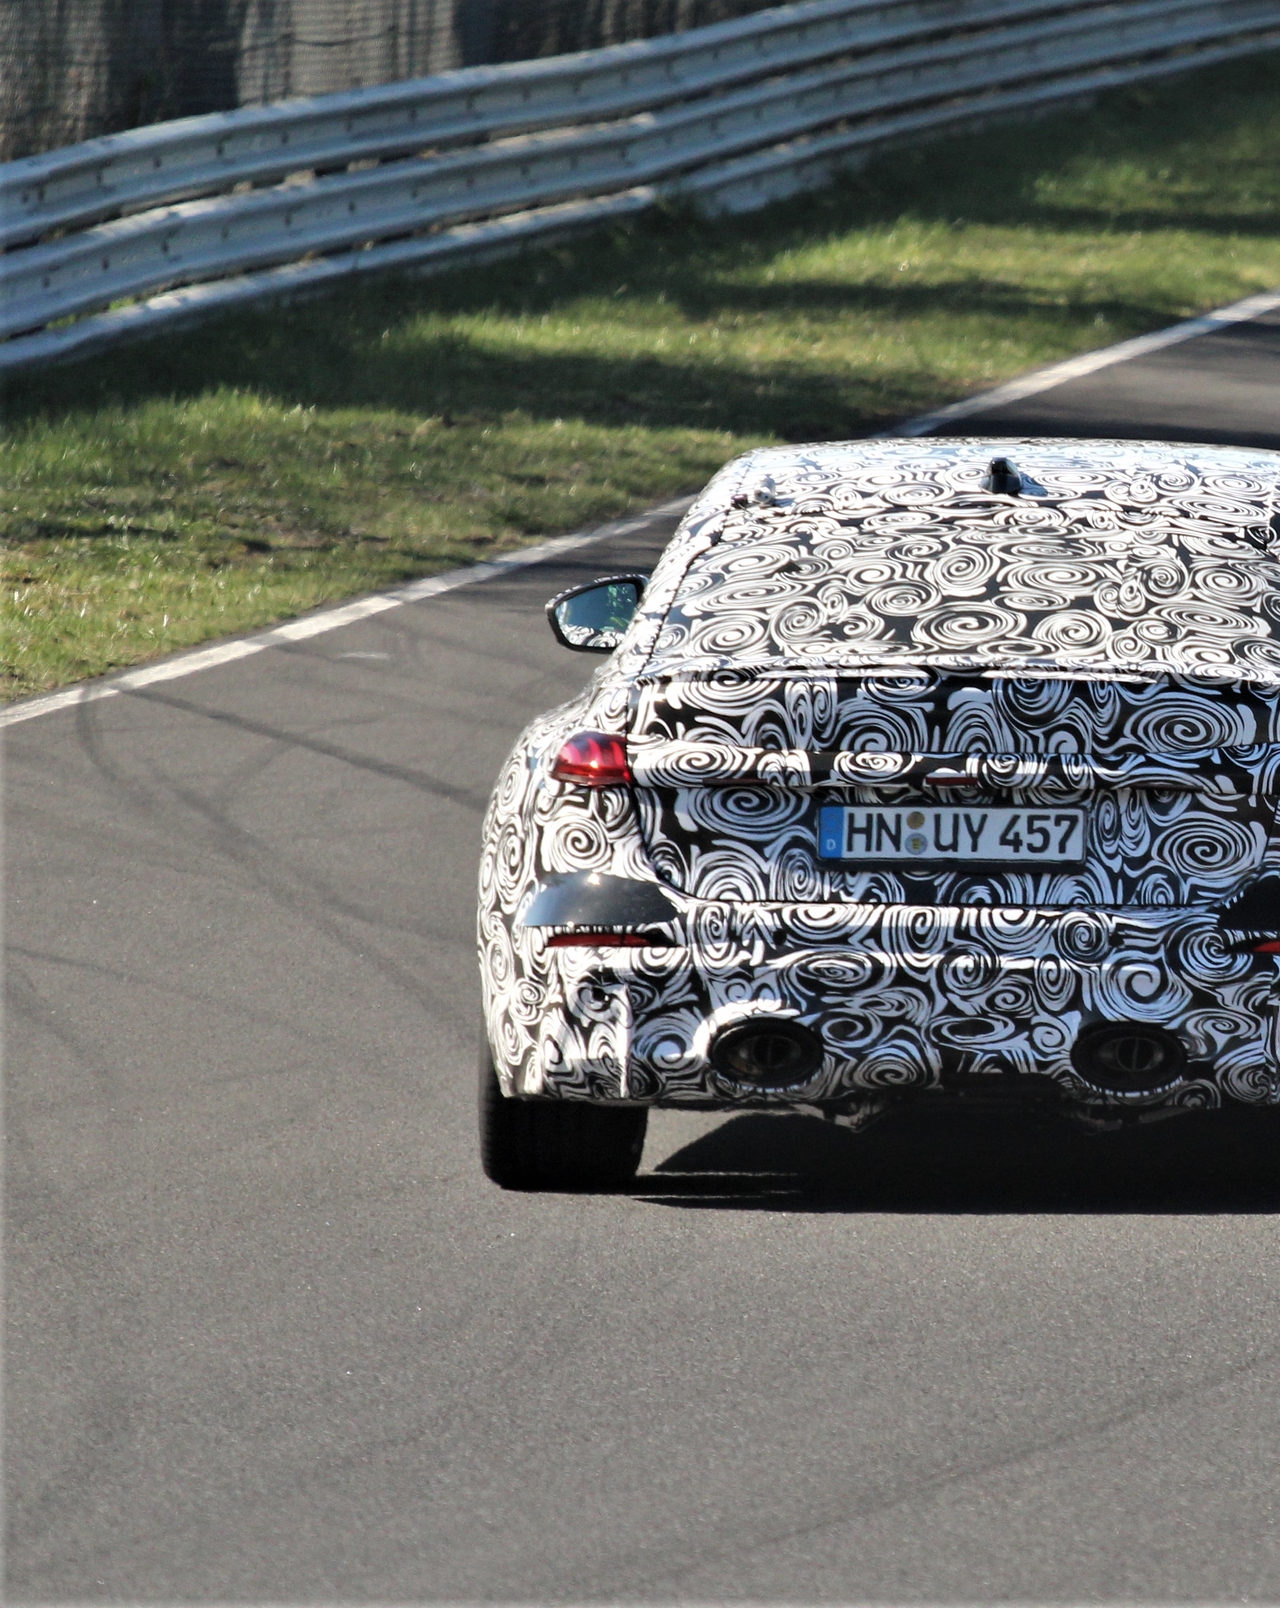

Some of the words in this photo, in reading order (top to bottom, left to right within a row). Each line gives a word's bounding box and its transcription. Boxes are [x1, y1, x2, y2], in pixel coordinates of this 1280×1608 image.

[826, 838, 836, 850] D
[846, 812, 901, 852] HN
[933, 813, 988, 852] UY
[998, 814, 1079, 854] 457
